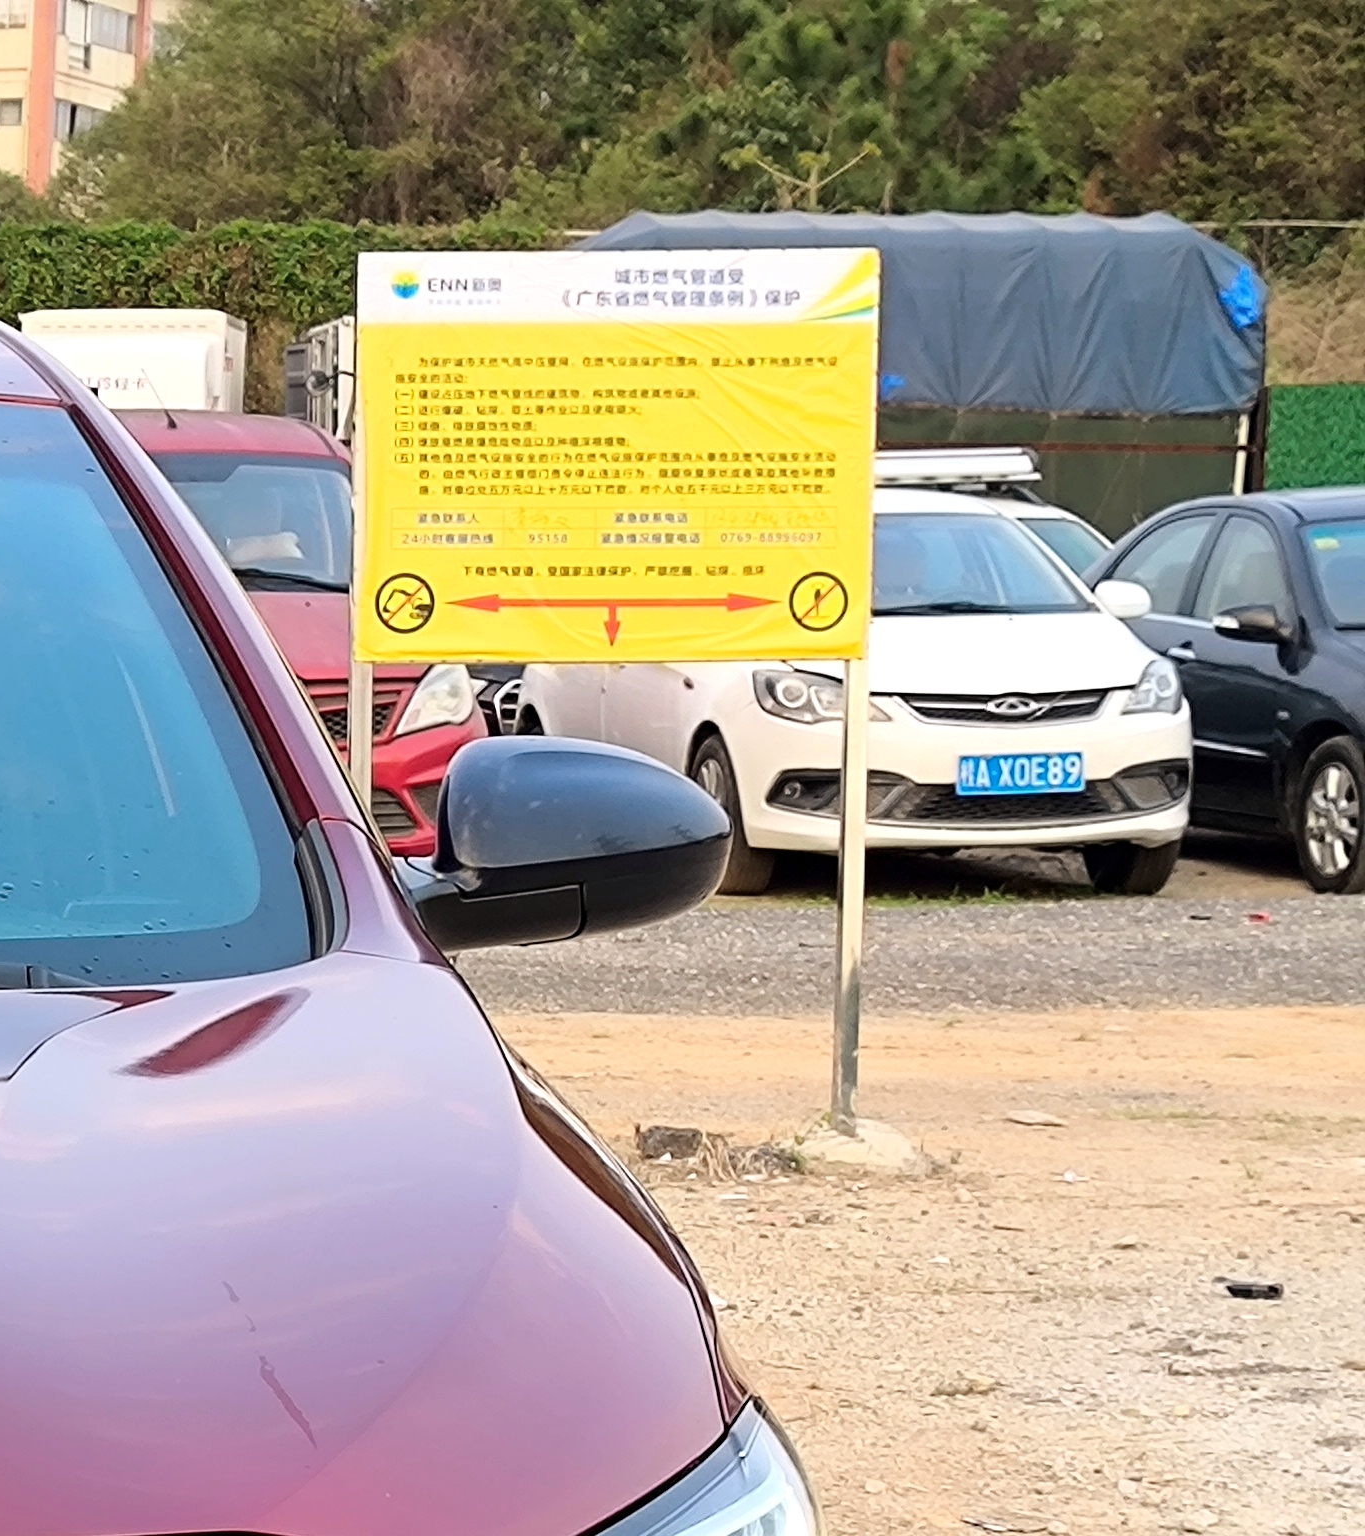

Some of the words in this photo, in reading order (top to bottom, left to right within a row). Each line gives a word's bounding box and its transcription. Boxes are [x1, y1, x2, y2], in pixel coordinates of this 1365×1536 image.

[427, 278, 468, 292] ENN
[615, 268, 744, 285] 城市燃气管道受
[562, 289, 801, 307] 《广东省燃气管理条例》保护
